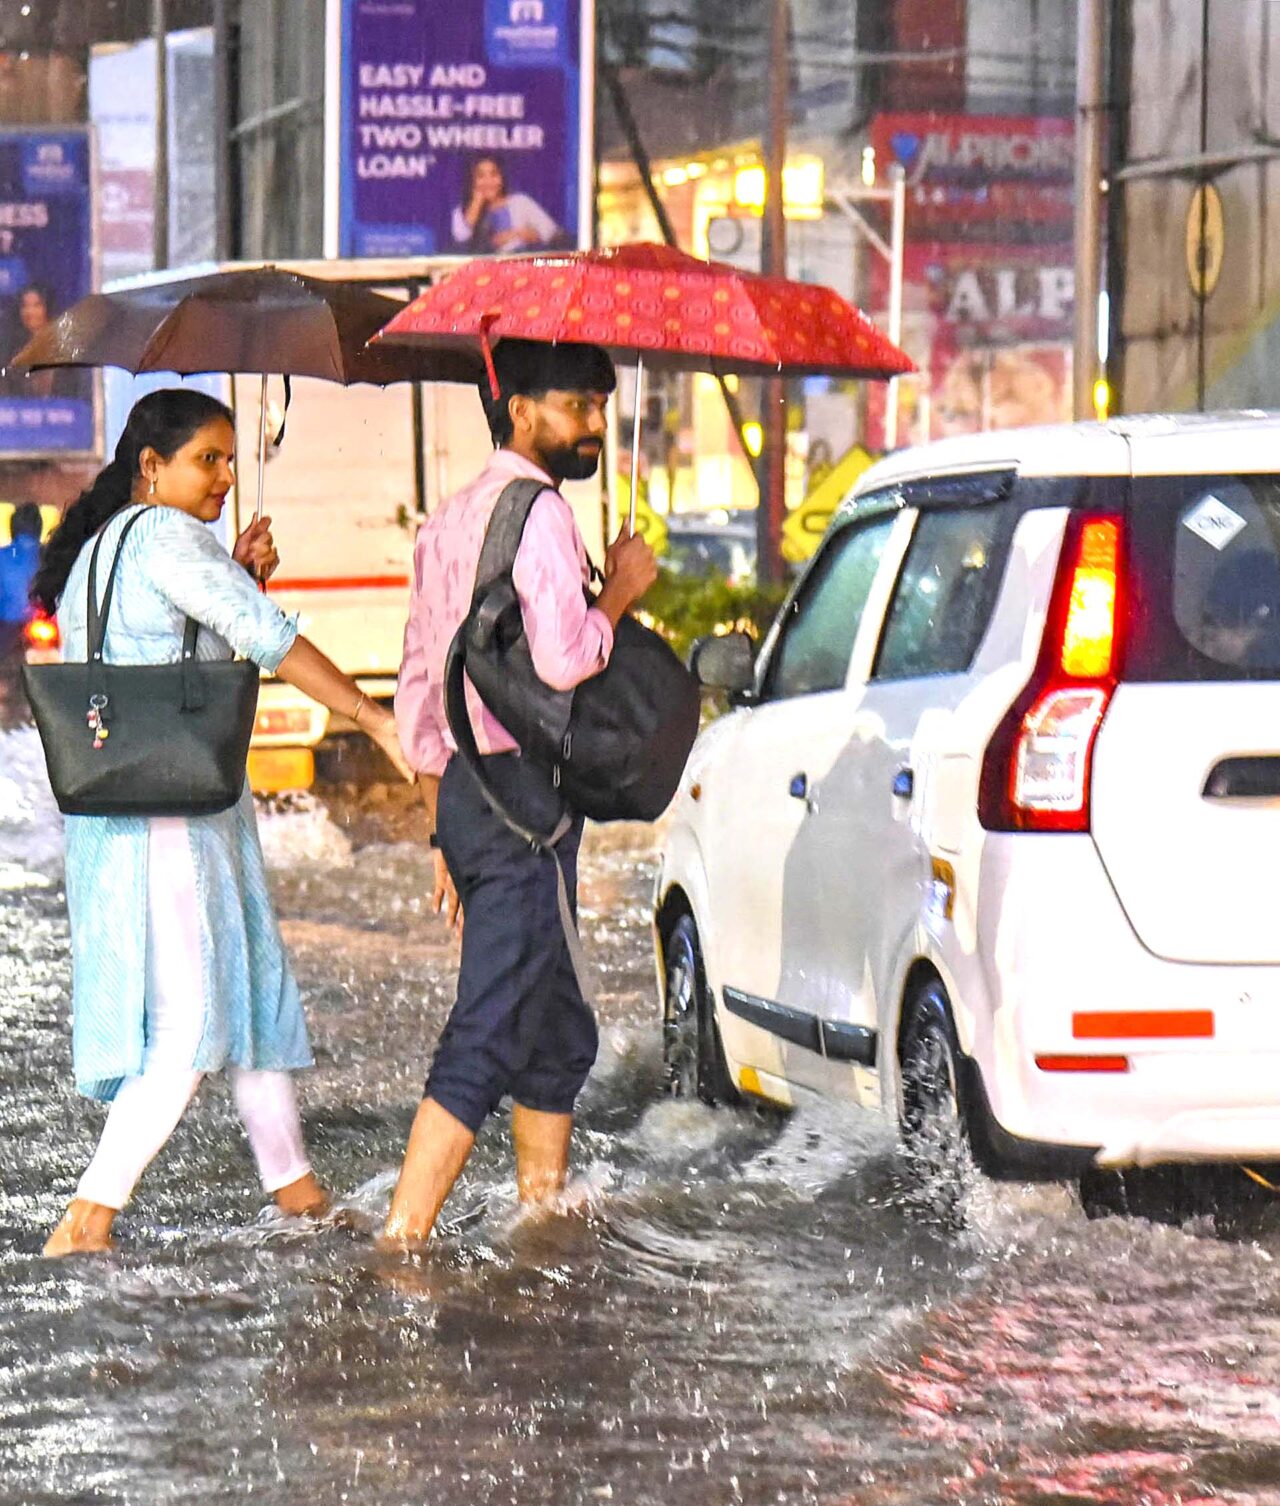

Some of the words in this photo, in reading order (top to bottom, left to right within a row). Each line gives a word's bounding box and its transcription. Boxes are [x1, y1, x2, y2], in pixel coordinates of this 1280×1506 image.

[359, 63, 425, 88] EASY
[429, 63, 487, 88] AND
[359, 94, 525, 119] HASSLE-FREE
[360, 125, 422, 149] TWO
[425, 125, 545, 150] WHEELER
